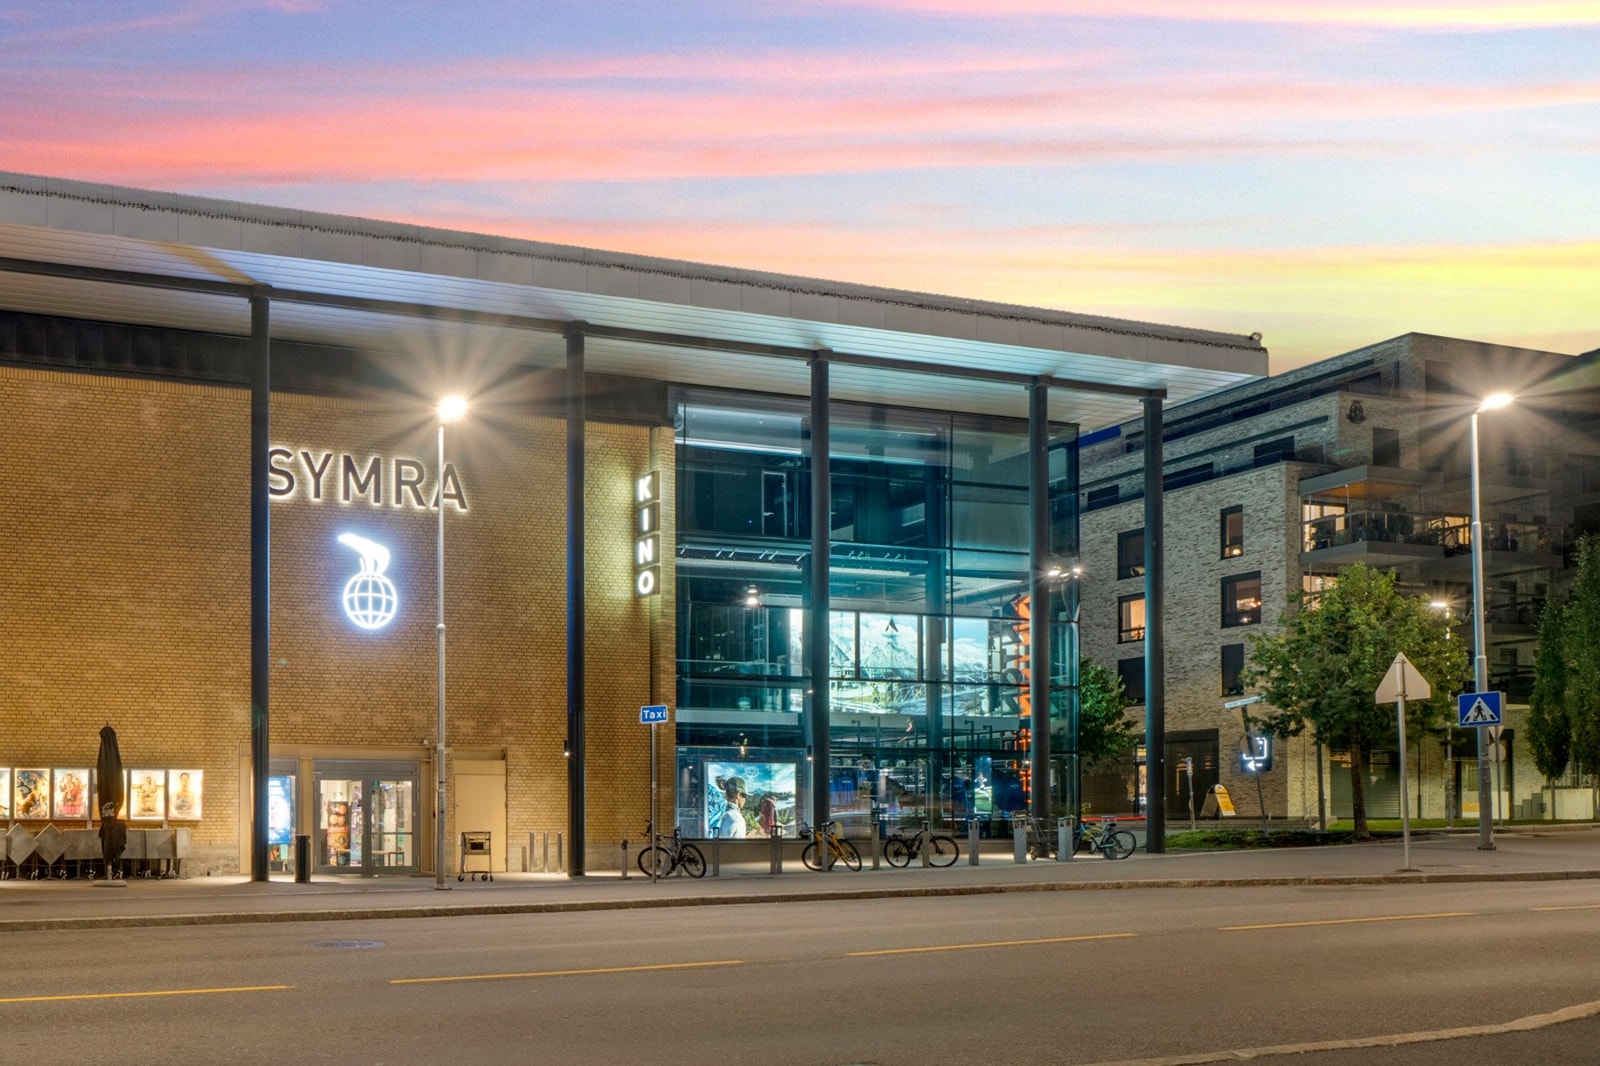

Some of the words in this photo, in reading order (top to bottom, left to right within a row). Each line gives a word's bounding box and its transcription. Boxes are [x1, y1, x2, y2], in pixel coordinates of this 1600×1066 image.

[269, 449, 467, 510] SYMRA
[638, 475, 652, 593] KINO
[643, 709, 666, 719] Taxi
